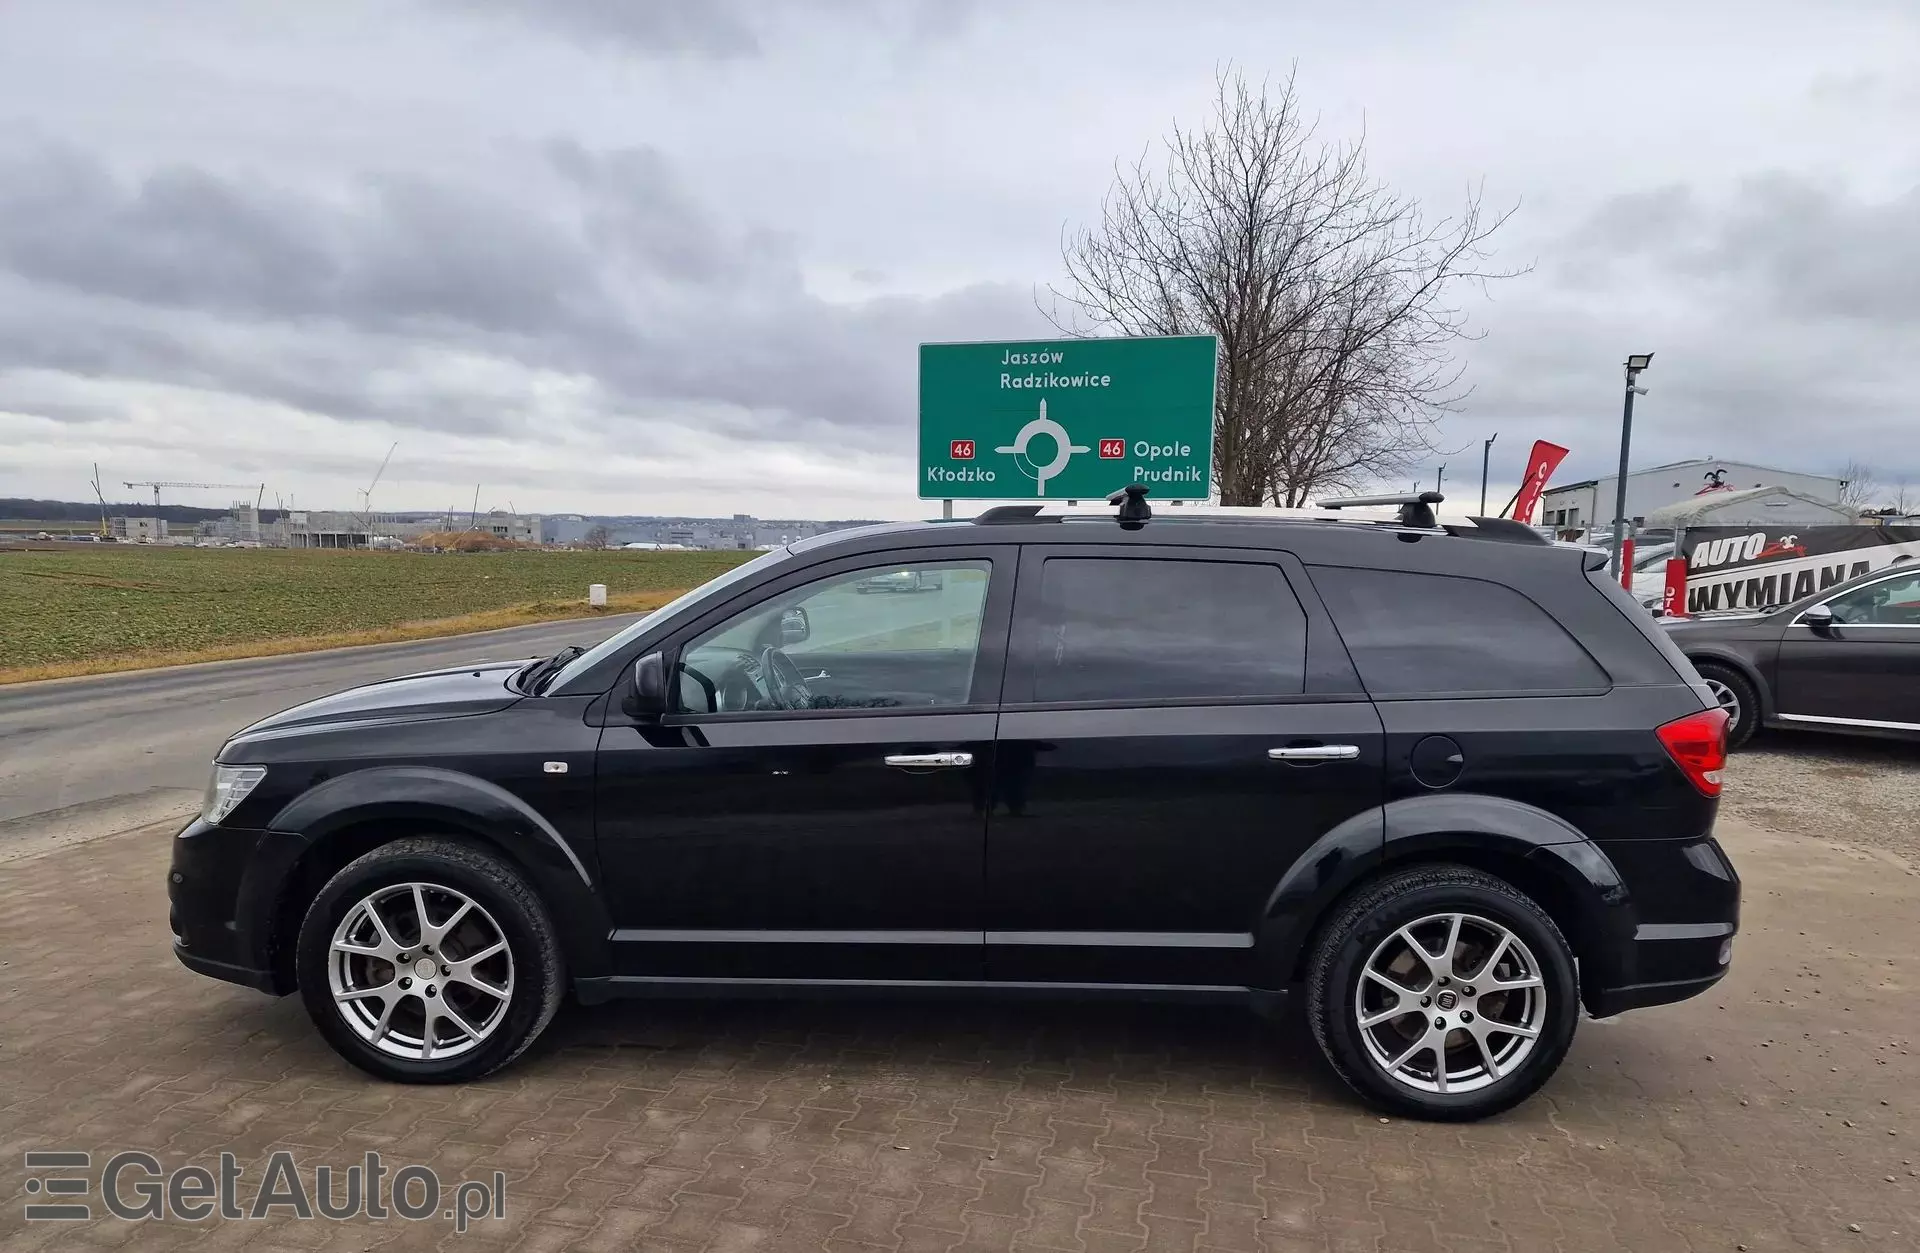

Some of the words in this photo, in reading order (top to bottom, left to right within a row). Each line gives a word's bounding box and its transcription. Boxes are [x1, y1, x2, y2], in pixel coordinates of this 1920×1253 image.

[1001, 347, 1064, 365] Jaszów
[1000, 371, 1111, 389] Radzikowice
[954, 443, 971, 457] 46
[1102, 441, 1121, 456] 46
[1133, 440, 1191, 461] Opole
[927, 466, 996, 482] Kłodzko
[1133, 465, 1202, 482] Prudnik
[1690, 532, 1767, 569] AUTO
